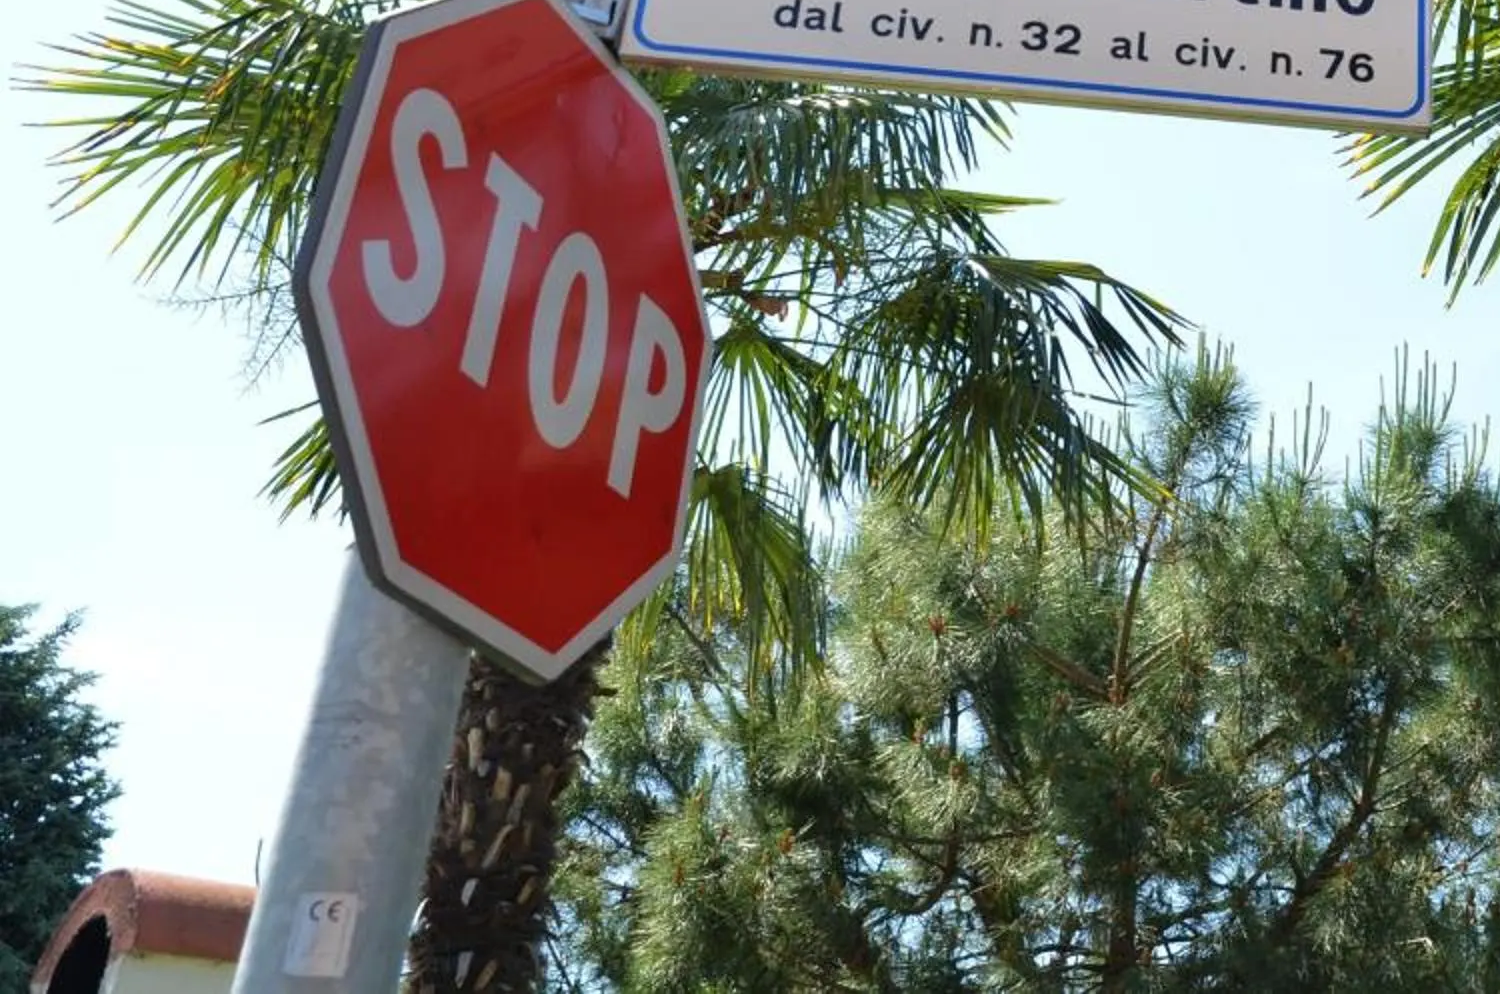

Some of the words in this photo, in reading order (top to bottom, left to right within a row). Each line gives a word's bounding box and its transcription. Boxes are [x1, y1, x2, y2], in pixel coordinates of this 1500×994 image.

[871, 6, 944, 43] civ.
[969, 22, 1003, 49] n.
[1020, 20, 1082, 56] 32
[1110, 31, 1149, 63] al
[1175, 36, 1247, 72] civ.
[1270, 51, 1304, 78] n.
[1319, 48, 1376, 83] 76
[362, 87, 686, 501] STOP
